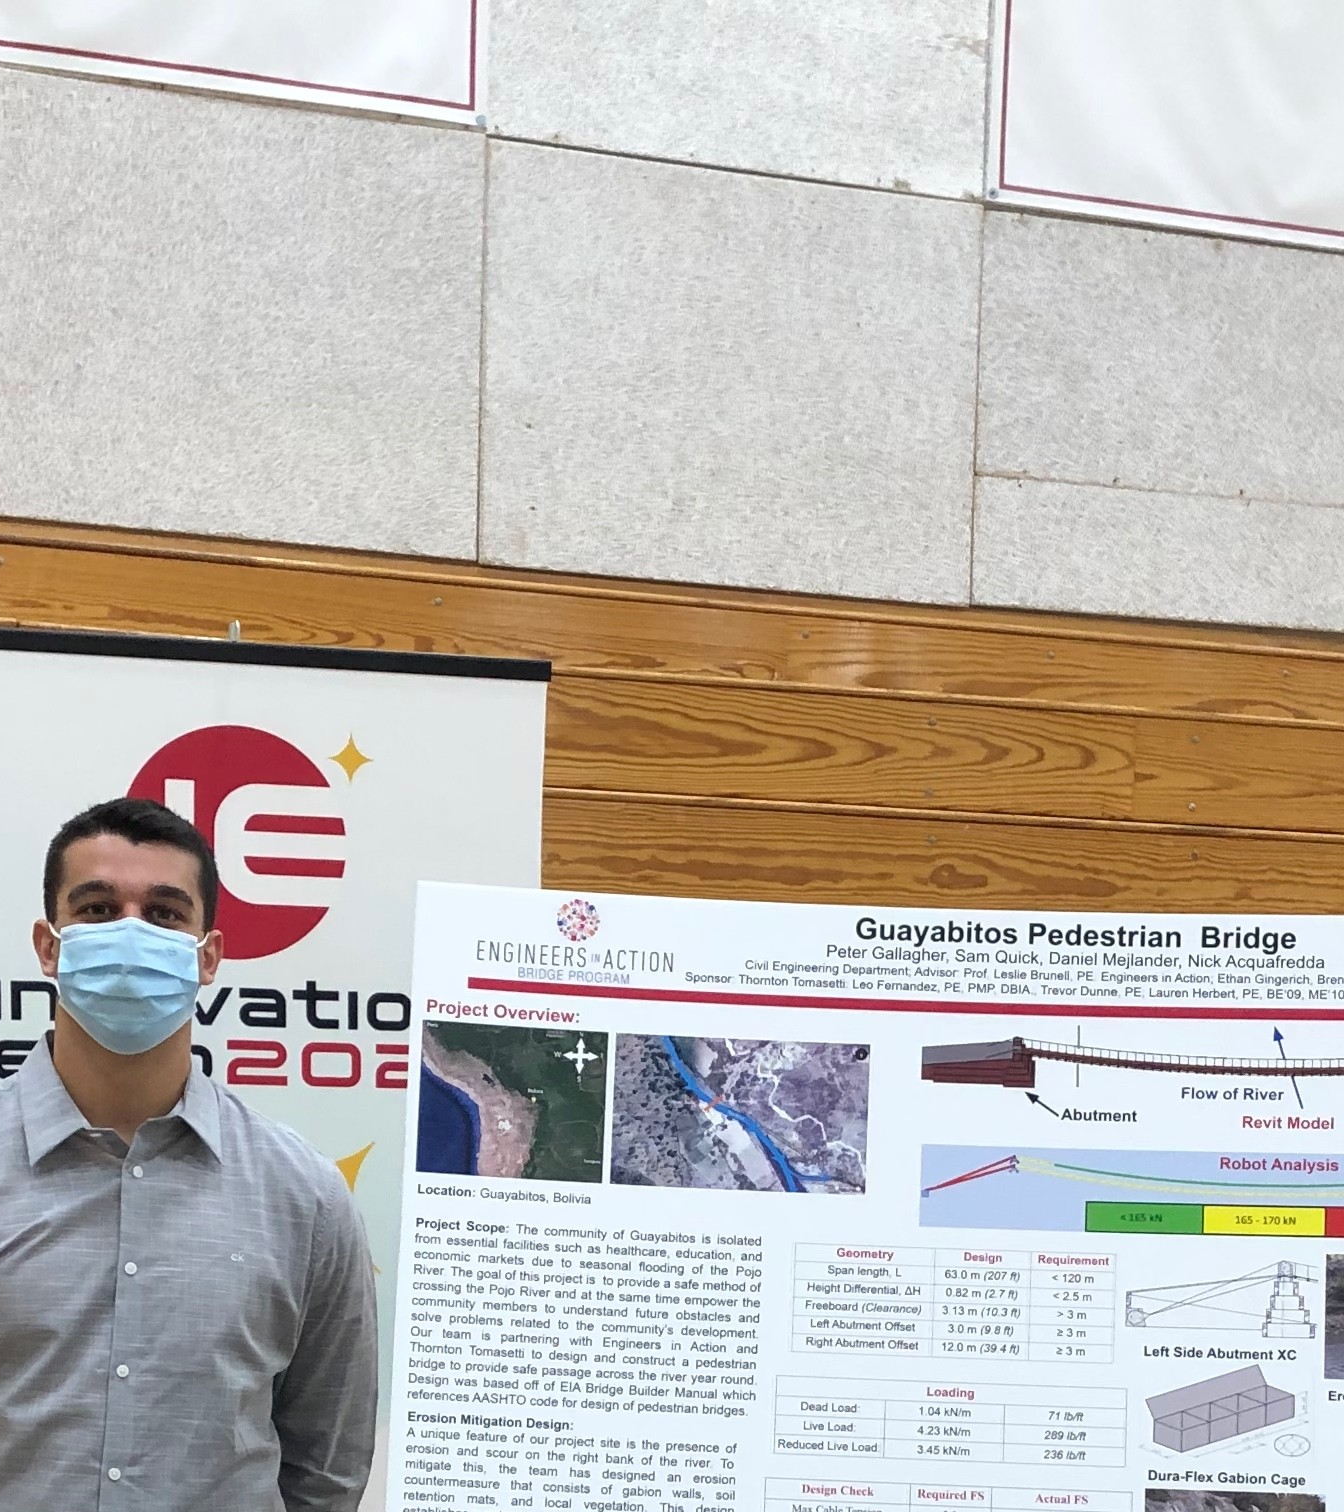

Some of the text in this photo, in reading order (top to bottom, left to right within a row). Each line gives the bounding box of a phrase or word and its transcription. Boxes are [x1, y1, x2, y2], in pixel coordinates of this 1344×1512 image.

[856, 917, 1296, 957] Guayabitos Pedestrian Bridge
[476, 940, 586, 969] ENGINEERS
[603, 949, 674, 975] ACTION
[826, 944, 1325, 972] Peter Gallagher, Sam Quick, Daniel Mejlander, Nick Acquafredda
[517, 968, 630, 984] BRIDGE PROGRAM
[425, 1000, 580, 1023] Project Overview:
[1181, 1087, 1284, 1100] Flow of River
[1058, 1108, 1137, 1122] Abutment
[1242, 1116, 1334, 1130] Revit Model
[1220, 1157, 1339, 1174] Robot Analysis
[418, 1184, 591, 1204] Location: Guayabitos, Bolivia
[1144, 1346, 1296, 1360] Left Side Abutment XC
[1148, 1470, 1306, 1488] Dura-Flex Gabion Cage
